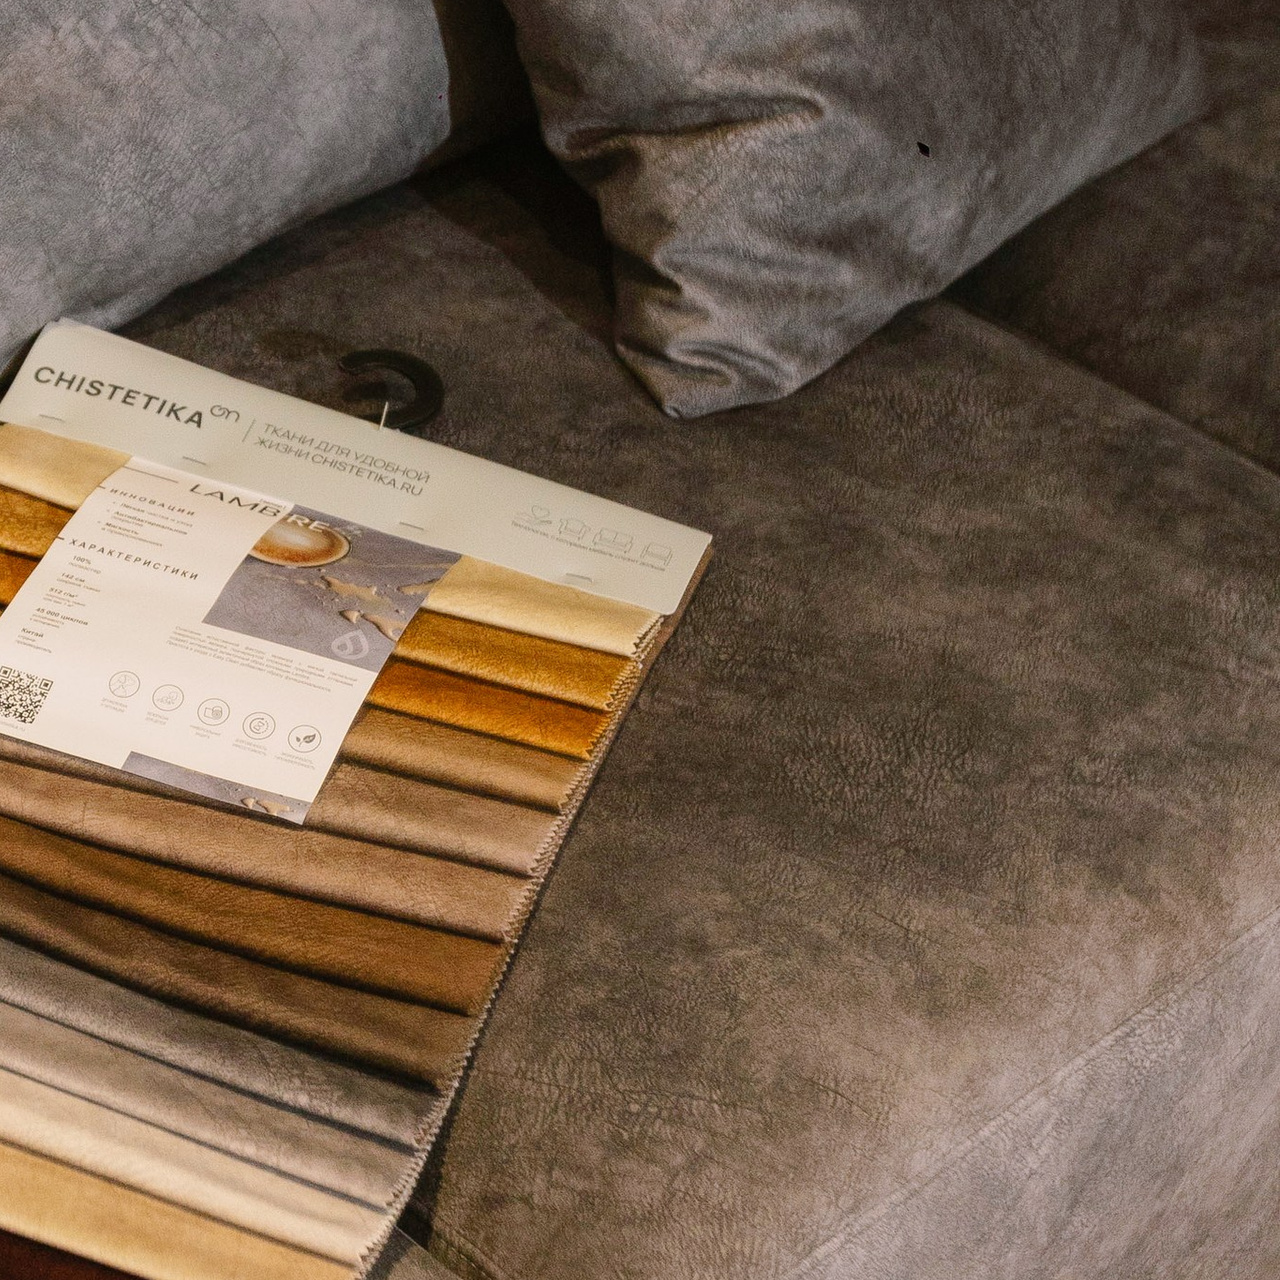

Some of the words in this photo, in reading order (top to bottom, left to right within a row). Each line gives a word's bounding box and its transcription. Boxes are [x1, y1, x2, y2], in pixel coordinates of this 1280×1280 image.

[34, 366, 204, 429] CHISTETIKA
[253, 436, 310, 461] ЖИЗНИ
[311, 454, 423, 497] CHISTETIKA.RU
[264, 423, 313, 448] ТКАНИ
[314, 439, 351, 459] ДЛЯ
[352, 451, 431, 484] УДОБНОЙ
[110, 488, 195, 516] ИННОВАЦИИ
[69, 537, 199, 581] ХАРАКТЕРИСТИКИ
[71, 555, 92, 564] 100%
